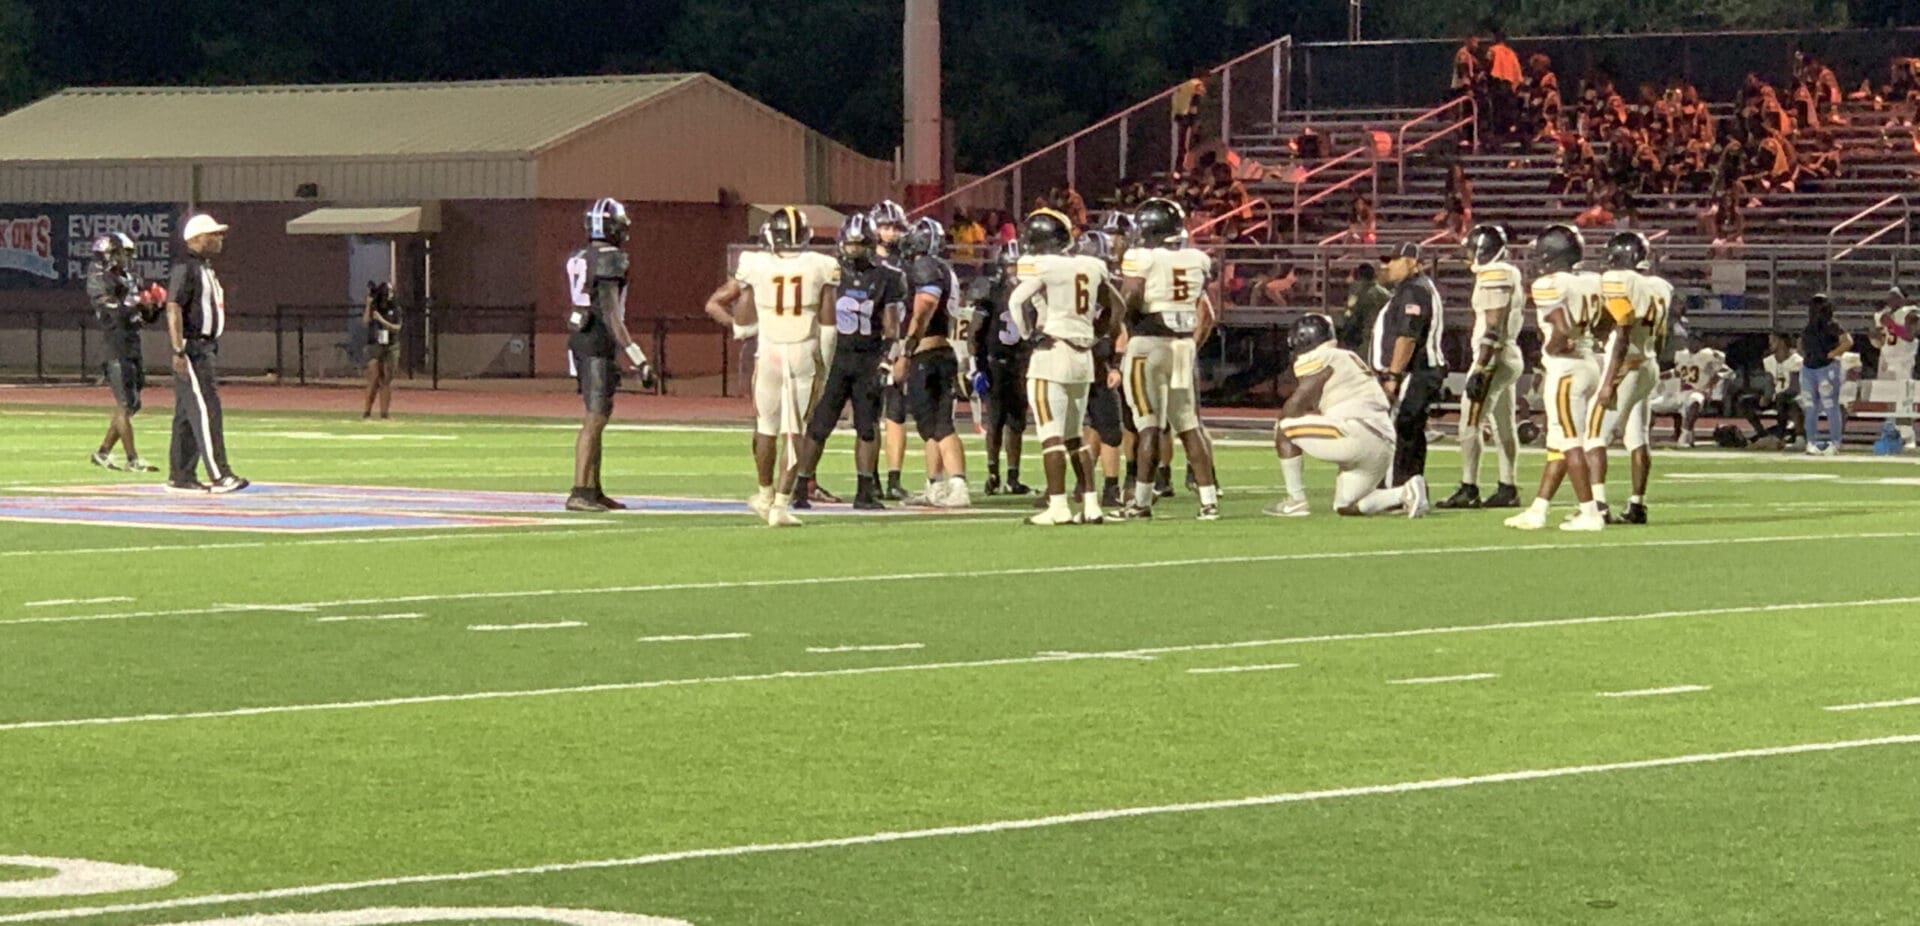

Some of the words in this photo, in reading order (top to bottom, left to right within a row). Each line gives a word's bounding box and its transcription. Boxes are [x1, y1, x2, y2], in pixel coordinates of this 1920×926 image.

[68, 214, 170, 238] EVERYONE
[771, 276, 803, 316] 11
[1075, 272, 1090, 315] 6
[1172, 268, 1189, 301] 5
[1680, 365, 1699, 383] 23
